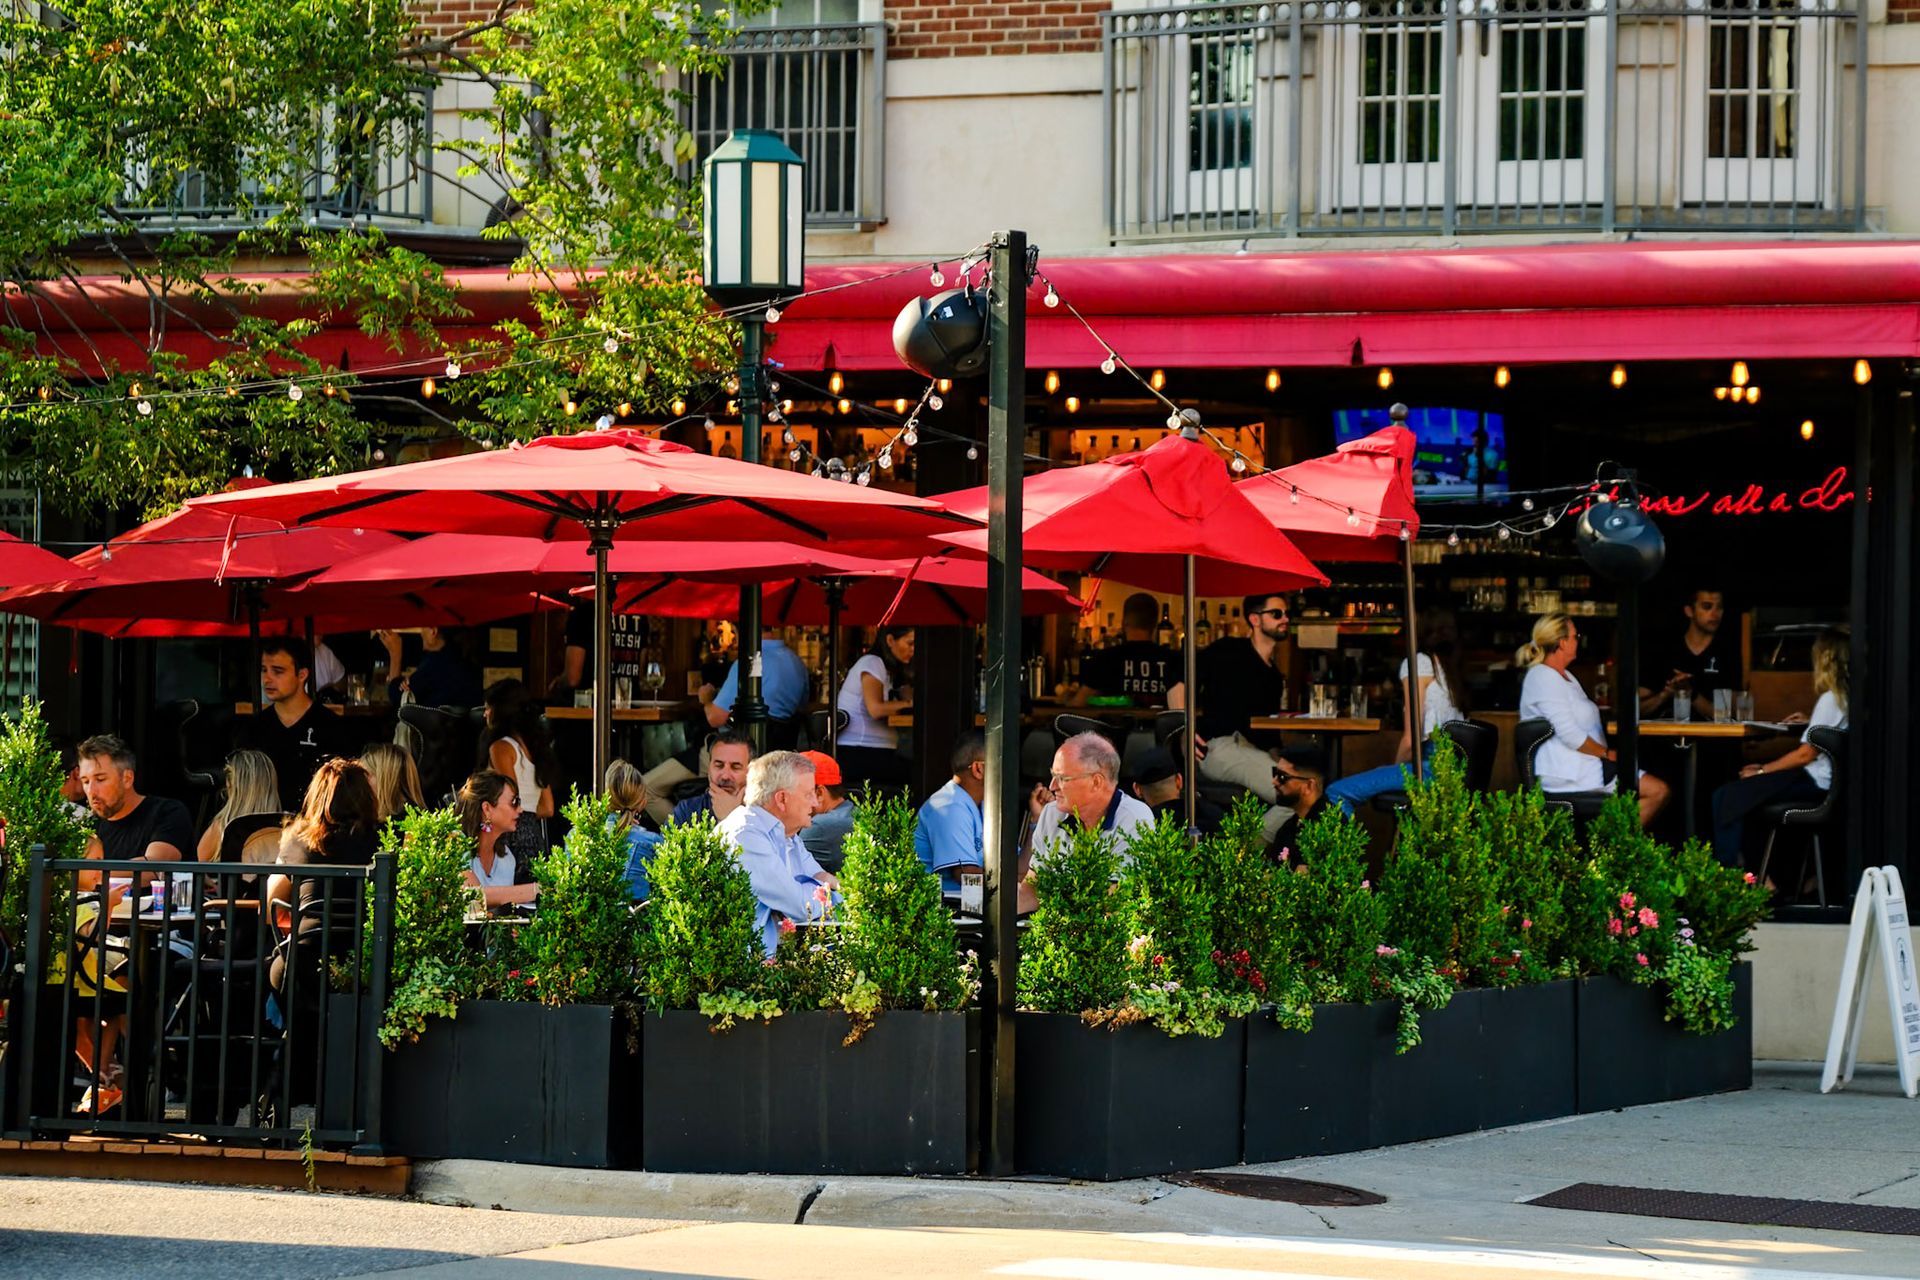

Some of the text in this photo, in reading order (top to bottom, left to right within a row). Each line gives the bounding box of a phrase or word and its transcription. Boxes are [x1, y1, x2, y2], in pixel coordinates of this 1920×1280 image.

[1713, 484, 1764, 515] all
[1769, 491, 1792, 512] a
[611, 632, 641, 649] RESH
[1124, 660, 1166, 678] HOT
